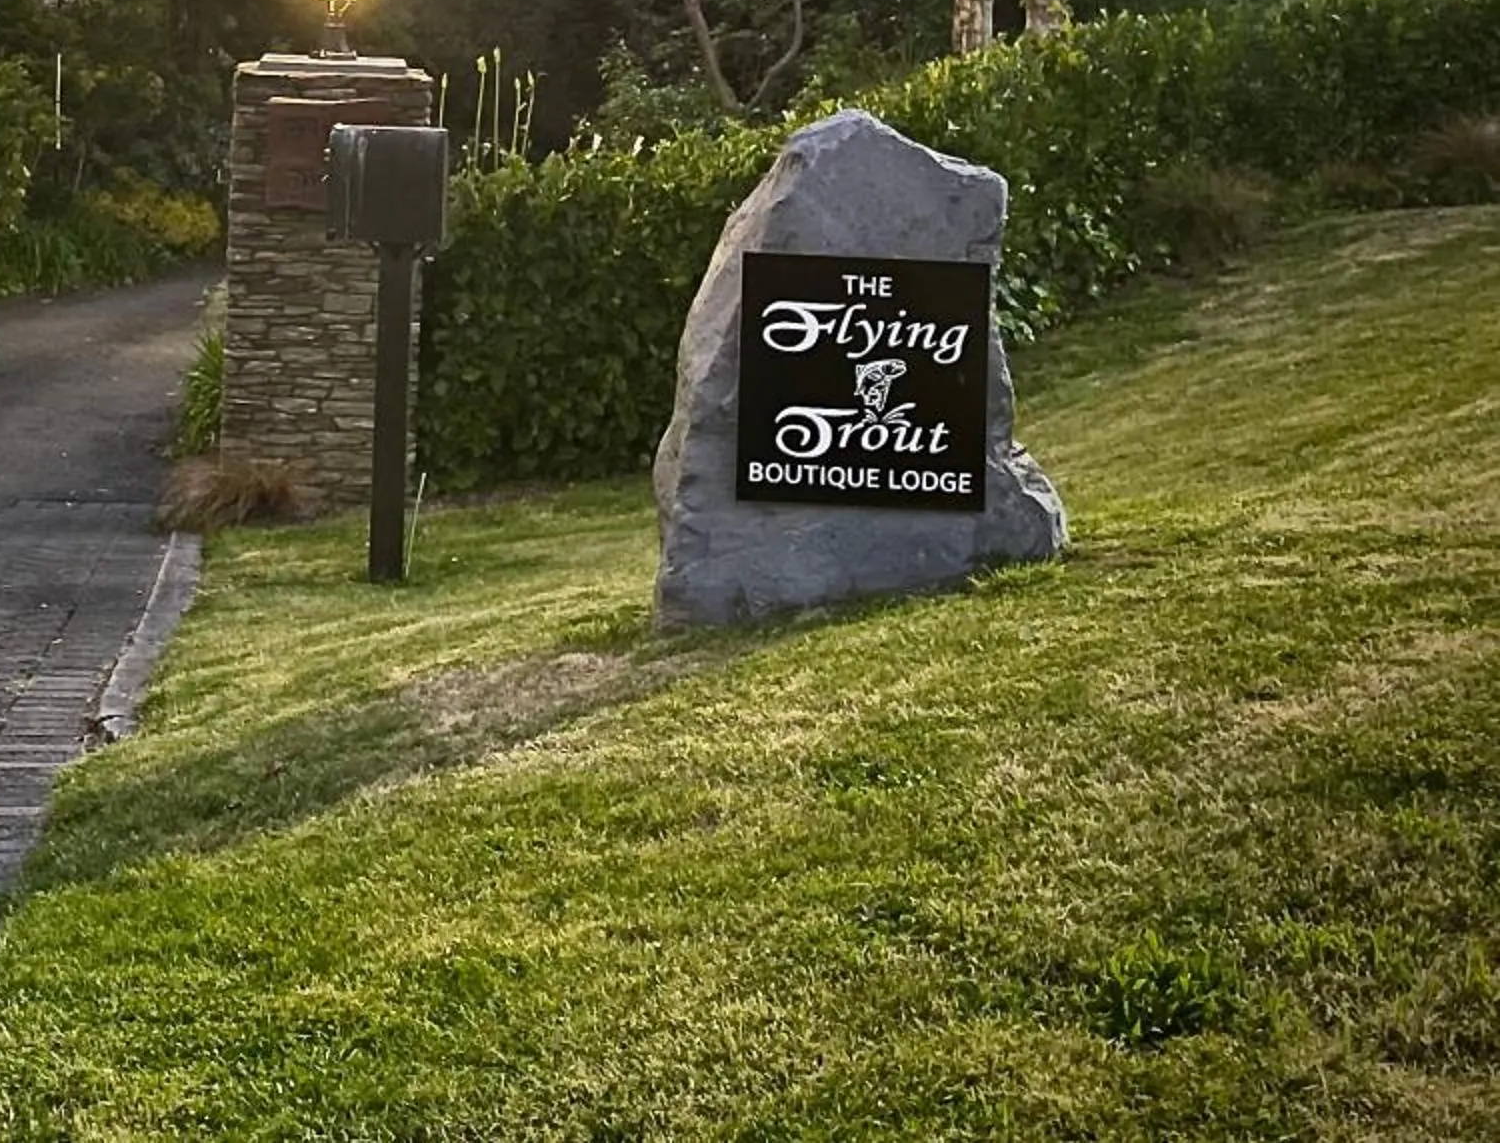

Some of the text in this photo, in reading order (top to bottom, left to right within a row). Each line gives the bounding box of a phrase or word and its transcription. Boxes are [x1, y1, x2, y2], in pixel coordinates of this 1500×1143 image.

[841, 274, 893, 297] THE
[762, 300, 969, 365] Flying
[775, 405, 950, 458] Trout
[748, 461, 973, 494] BOUTIQUE LODGE
